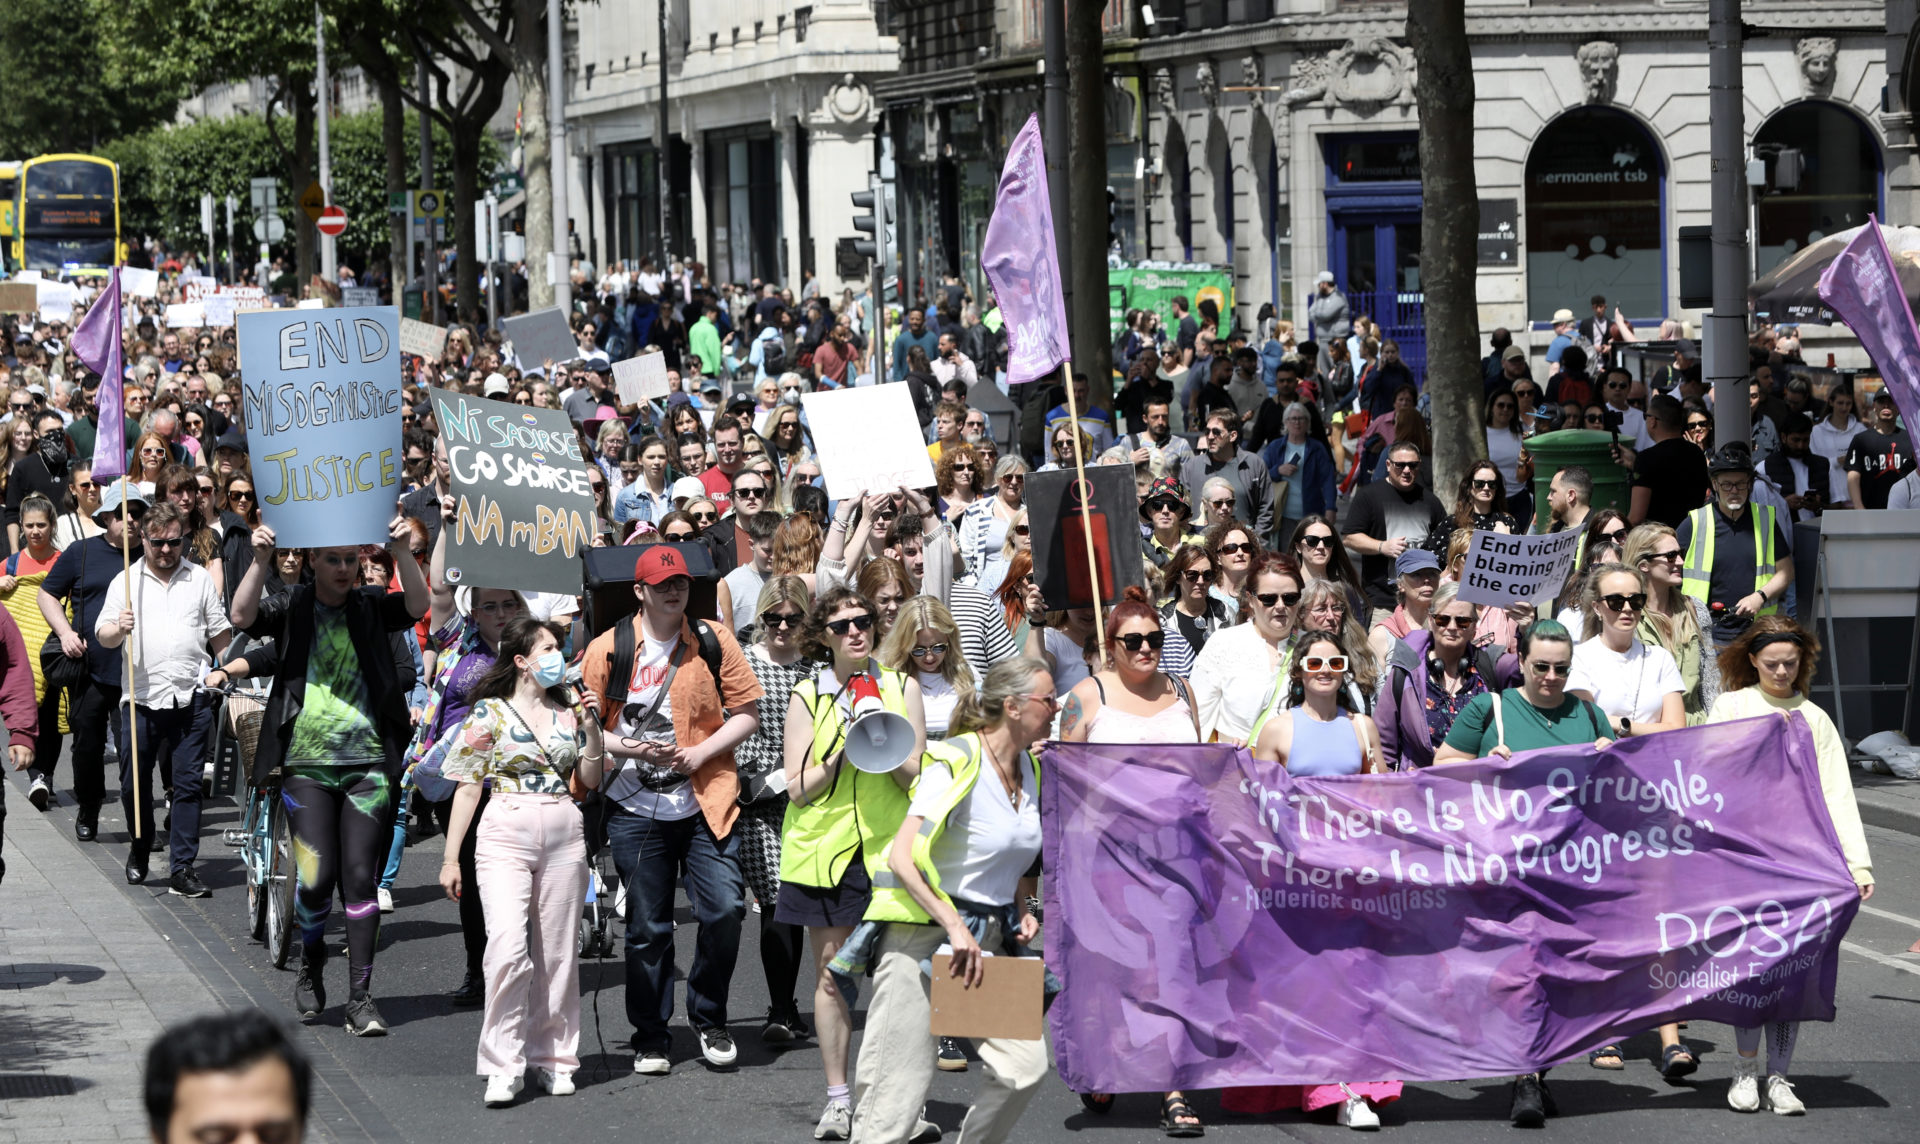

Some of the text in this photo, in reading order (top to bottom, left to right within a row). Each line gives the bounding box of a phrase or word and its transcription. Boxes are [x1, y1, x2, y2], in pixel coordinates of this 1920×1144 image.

[1624, 168, 1648, 182] tsb
[279, 318, 390, 371] END
[487, 415, 584, 462] SAOIRSE
[449, 445, 592, 497] GO SAOIRSE
[455, 494, 599, 559] NA mBAN
[1480, 535, 1576, 557] End victim
[1468, 572, 1502, 592] the
[1474, 553, 1570, 577] blaming in
[1289, 793, 1419, 841] There
[1424, 786, 1465, 834] Is
[1471, 775, 1533, 825] No
[1546, 758, 1725, 818] Struggle,
[1252, 839, 1381, 891] There
[1443, 841, 1509, 887] No
[1244, 884, 1345, 912] Frederick
[1351, 887, 1448, 920] Douglass
[1655, 895, 1833, 959] ROSA
[1648, 949, 1821, 990] Socialist Feminist
[1685, 985, 1786, 1009] vement
